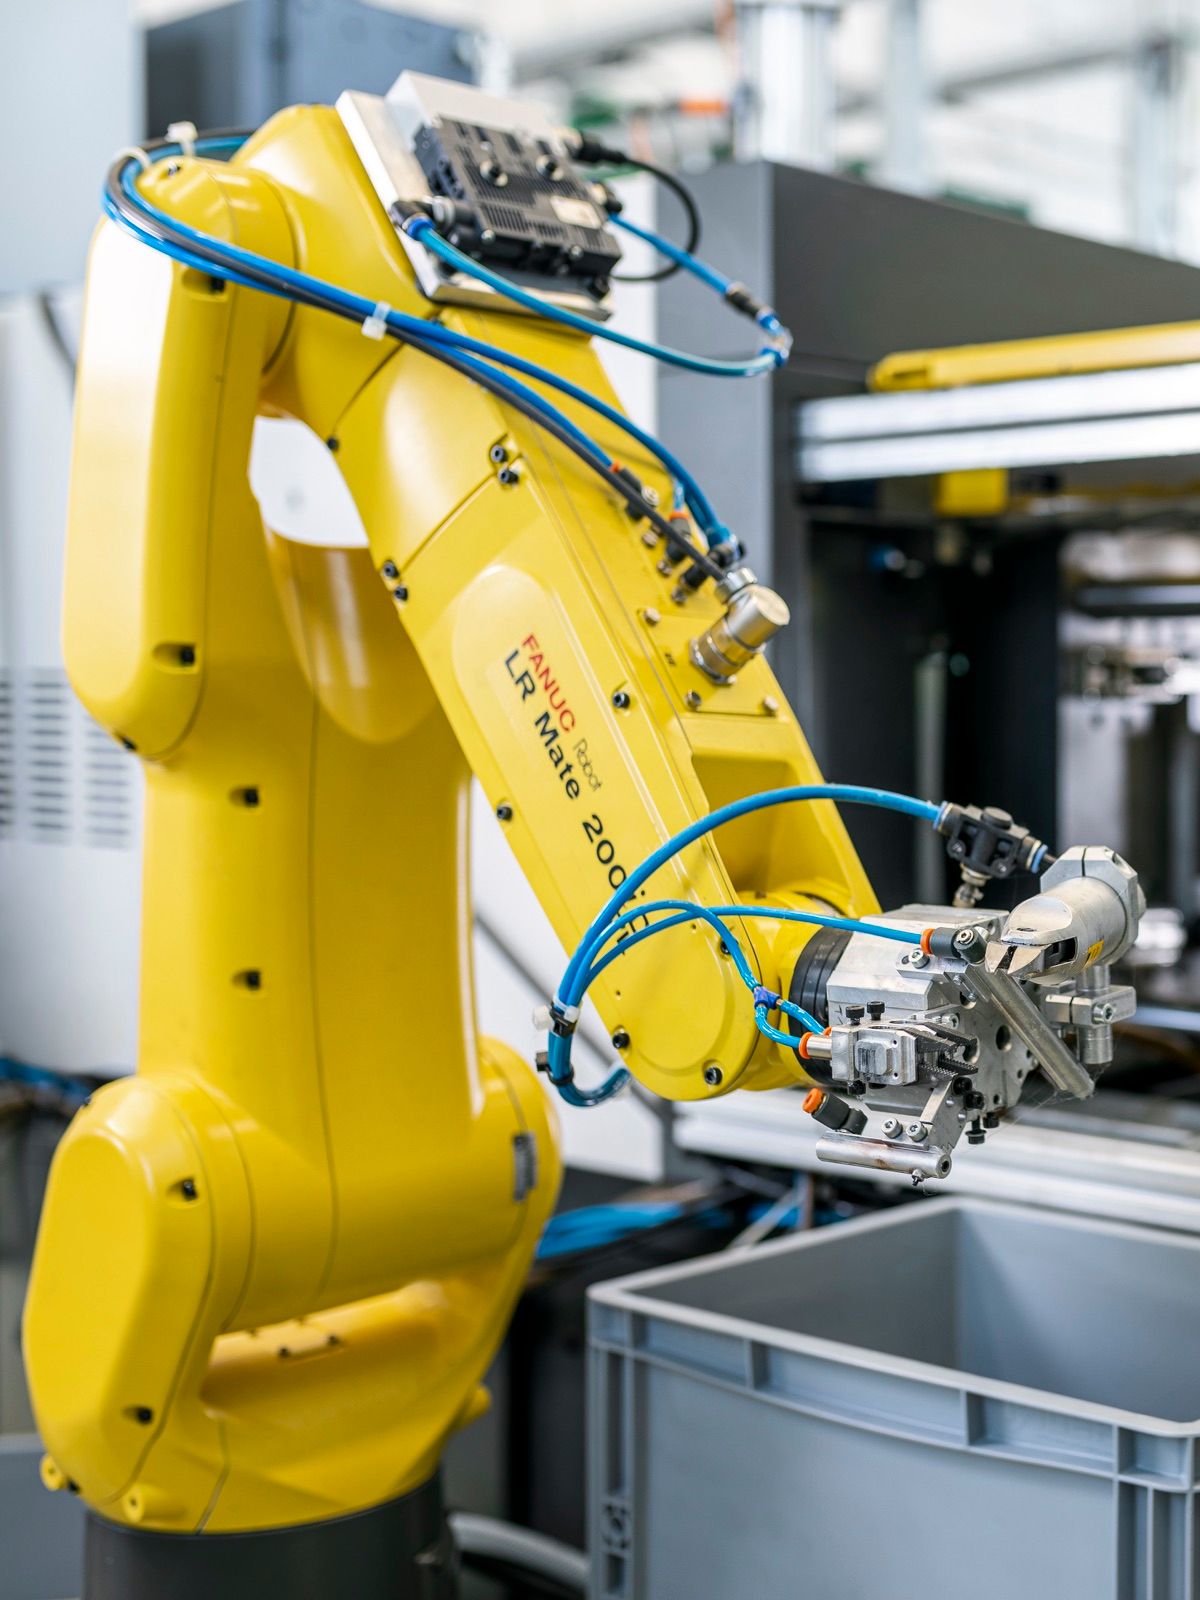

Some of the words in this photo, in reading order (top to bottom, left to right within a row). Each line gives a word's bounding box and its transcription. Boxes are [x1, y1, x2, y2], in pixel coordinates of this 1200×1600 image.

[505, 649, 536, 701] LR
[534, 711, 579, 800] Mate
[522, 634, 575, 732] FANUC
[574, 737, 602, 791] Robot
